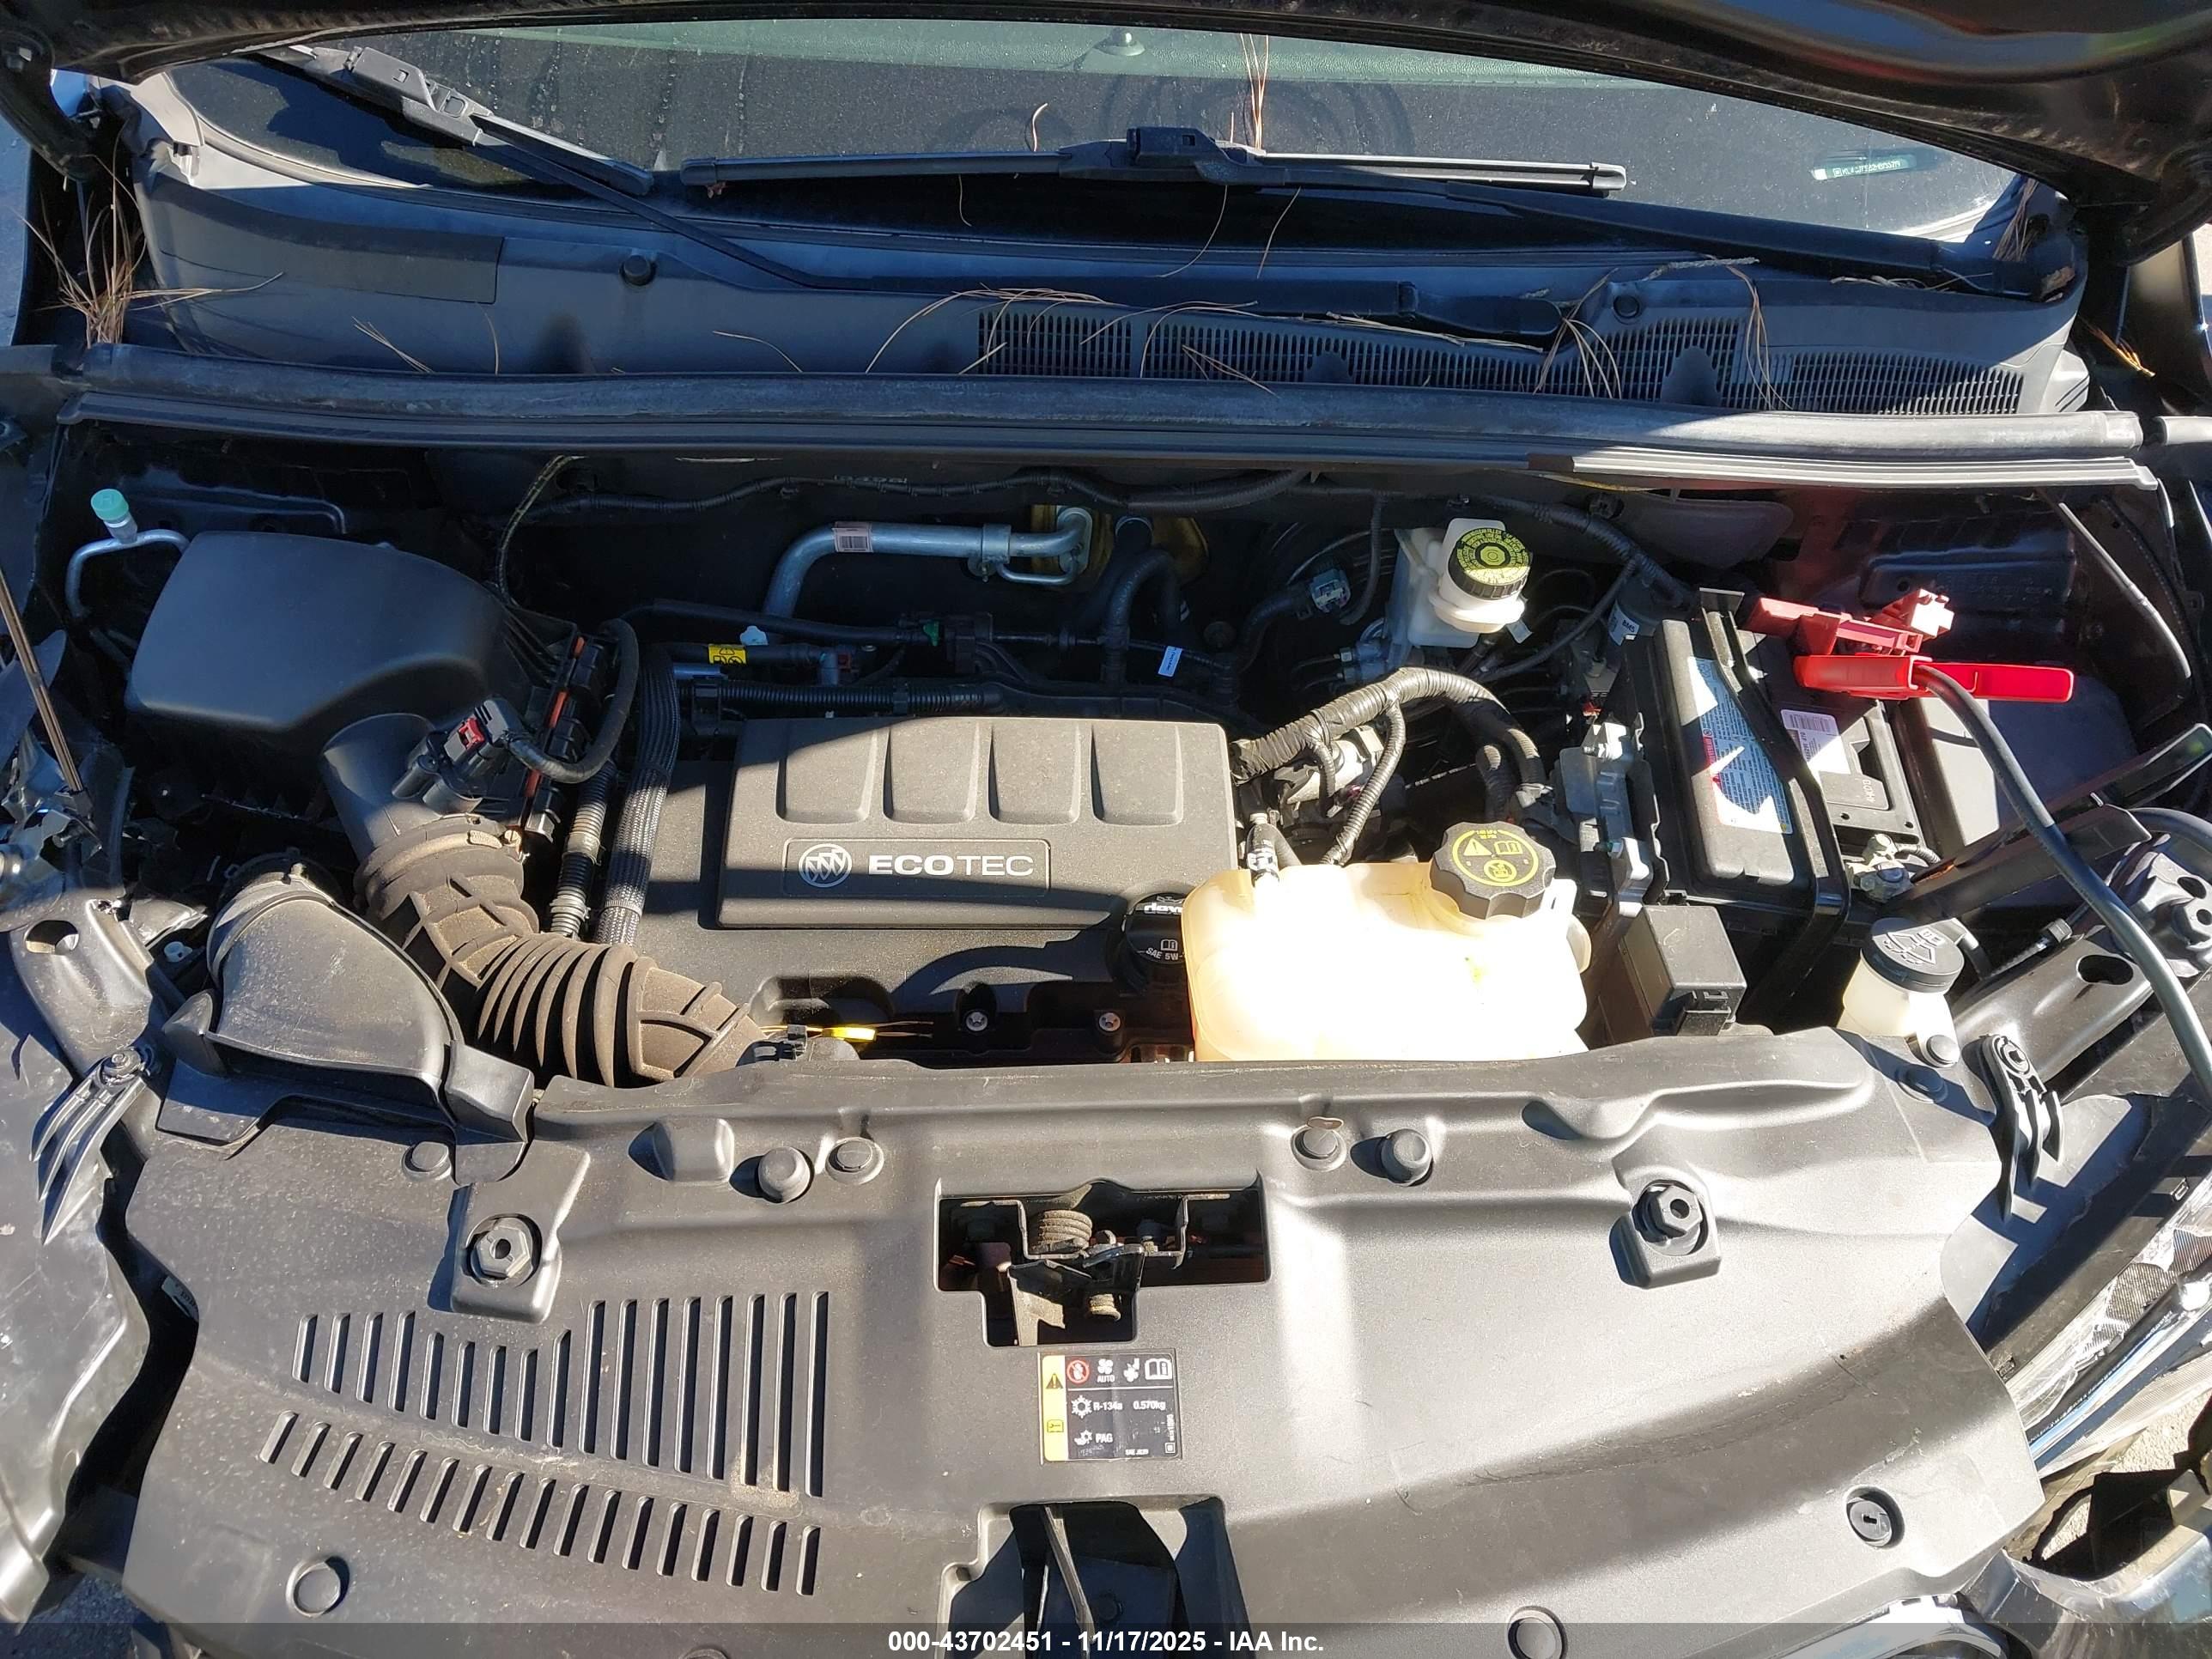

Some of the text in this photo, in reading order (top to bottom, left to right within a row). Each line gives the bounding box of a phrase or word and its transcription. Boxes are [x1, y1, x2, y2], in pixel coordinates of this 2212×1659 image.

[868, 854, 1034, 876] ECOTEC
[1144, 902, 1183, 915] dex
[1146, 947, 1185, 961] SAE 5W-
[1093, 1401, 1166, 1412] R-134a 0.570kg
[1096, 1433, 1114, 1443] PAG
